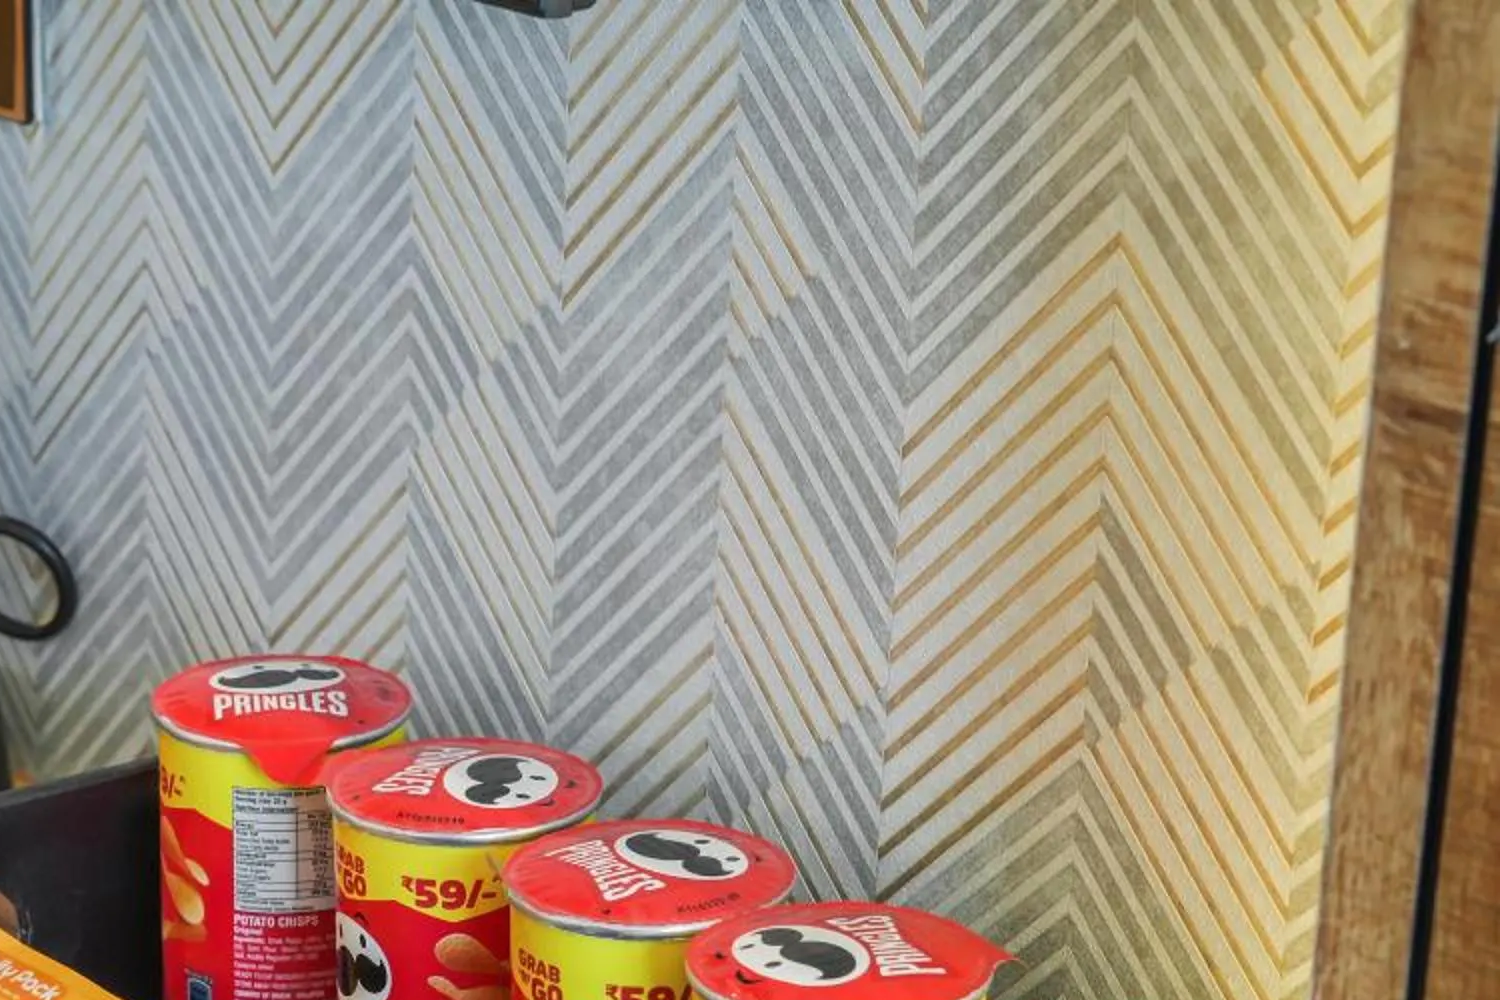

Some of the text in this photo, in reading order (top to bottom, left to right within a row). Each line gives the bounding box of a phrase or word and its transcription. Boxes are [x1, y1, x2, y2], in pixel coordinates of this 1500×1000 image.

[212, 691, 349, 721] PRINGLES
[371, 746, 480, 796] PRINGLES
[338, 843, 365, 875] RAB
[543, 839, 667, 902] PRINGLES
[342, 868, 367, 897] GO
[233, 913, 319, 928] POTATO CRISPS
[826, 914, 947, 977] PRINGLES
[518, 947, 561, 984] GRAB
